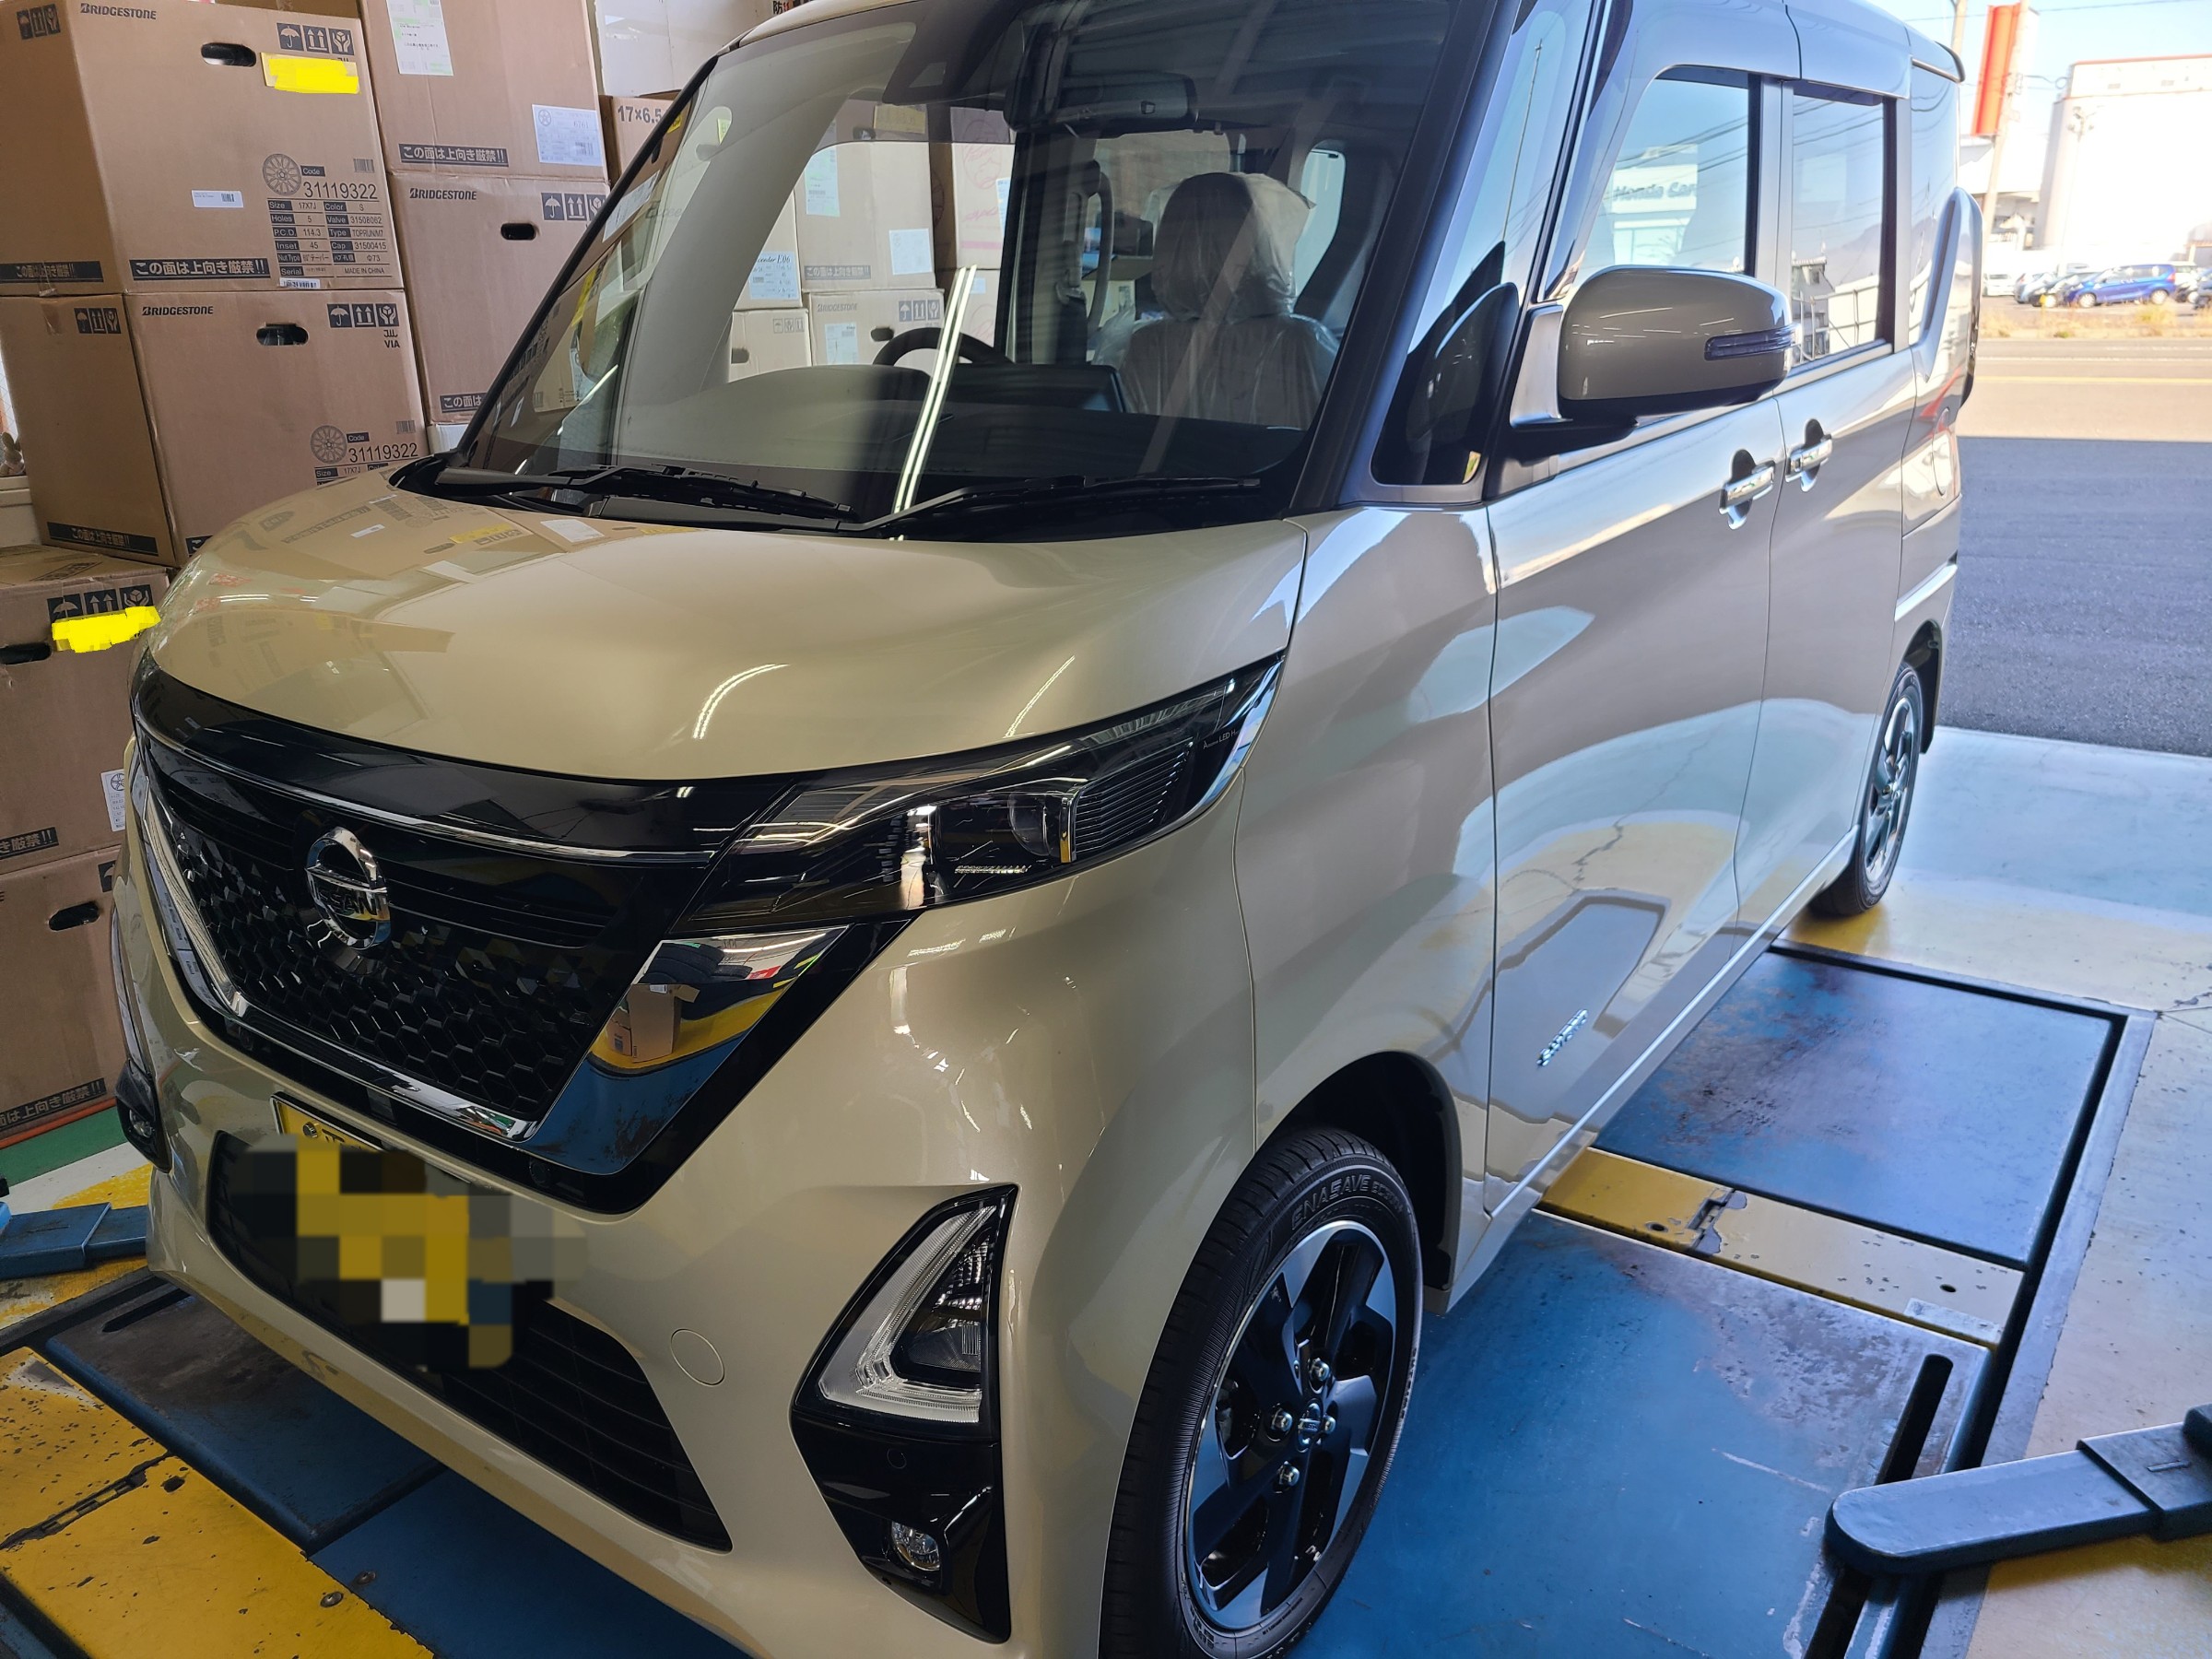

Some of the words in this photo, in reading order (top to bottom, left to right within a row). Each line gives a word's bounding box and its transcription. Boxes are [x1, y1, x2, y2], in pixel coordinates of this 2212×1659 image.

[80, 3, 157, 19] BRIDGESTONE
[302, 167, 321, 175] Code
[303, 182, 378, 199] 31119322
[409, 187, 477, 200] BRIDGESTONE
[269, 201, 285, 209] Size
[271, 214, 293, 222] Holes
[327, 216, 346, 224] Valve
[328, 229, 347, 238] Type
[276, 241, 298, 250] Inset
[310, 241, 319, 250] 45
[332, 241, 346, 251] Cap
[281, 267, 302, 276] Serial
[142, 306, 214, 316] BRIDGESTONE
[384, 339, 400, 348] VIA
[348, 443, 418, 463] 31119322
[1292, 1173, 1371, 1230] ENASAVE
